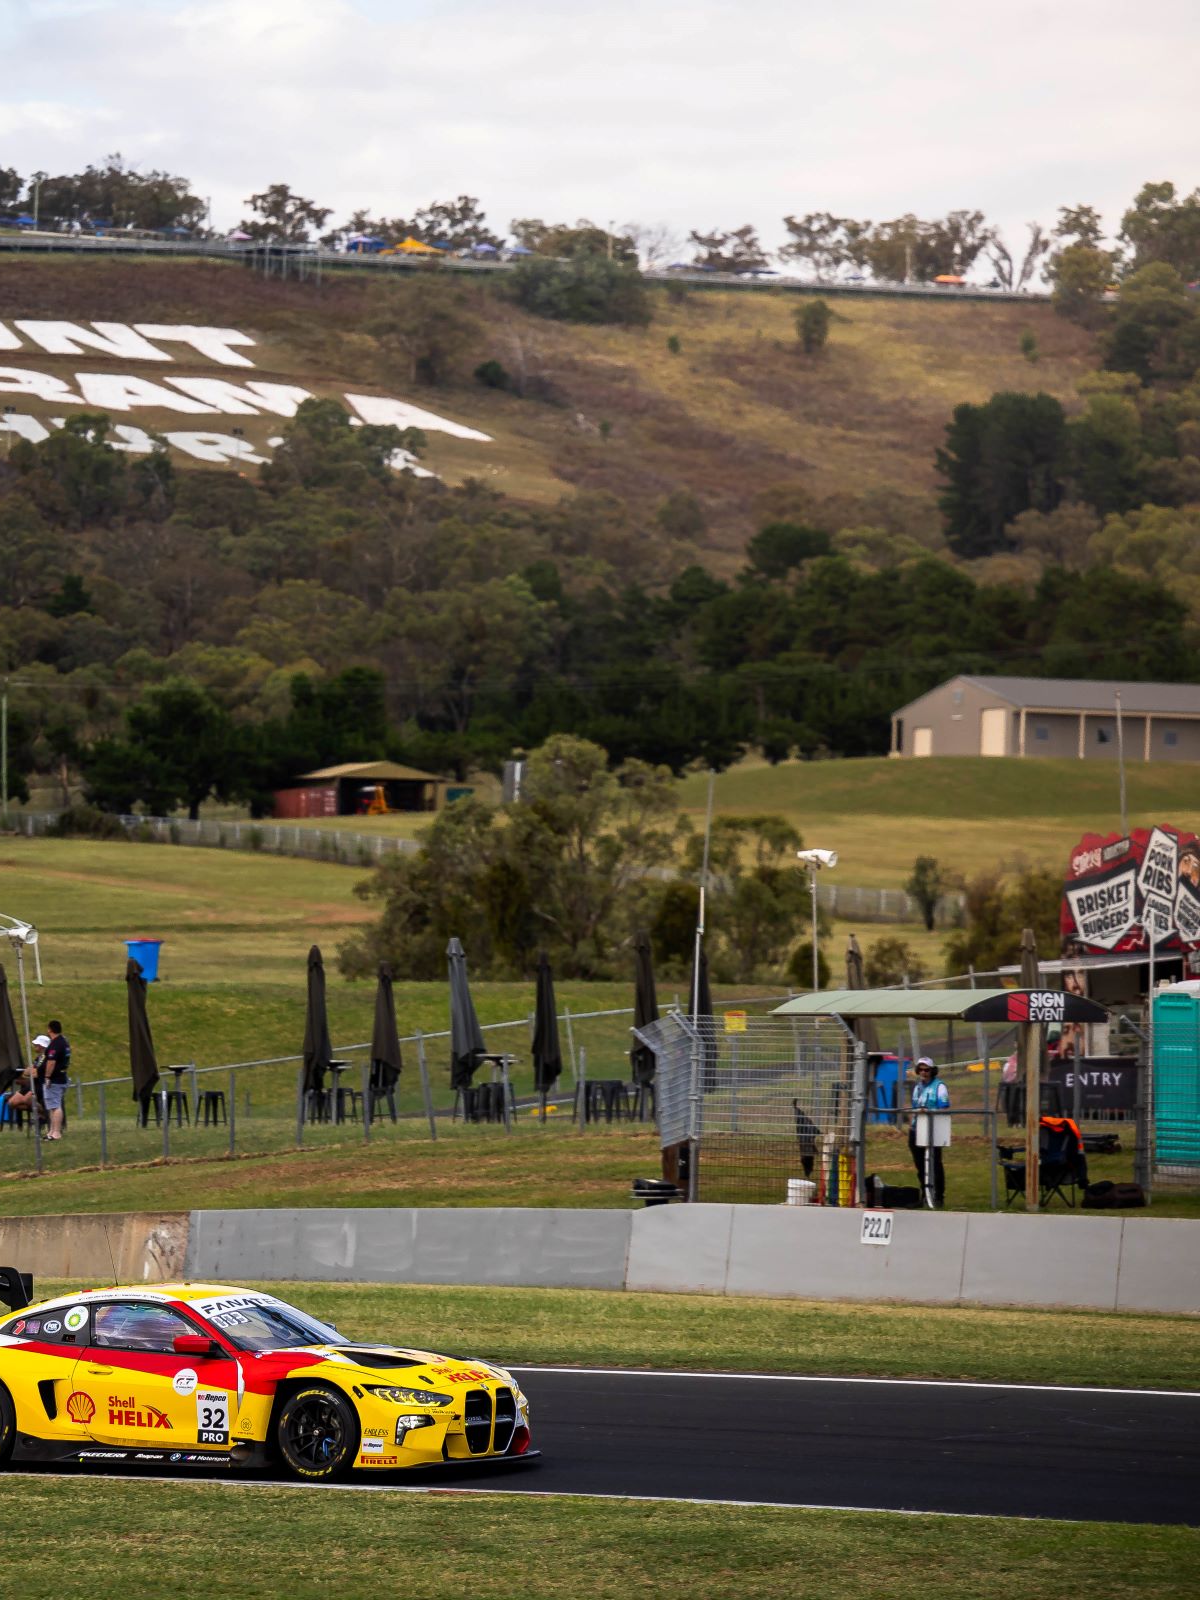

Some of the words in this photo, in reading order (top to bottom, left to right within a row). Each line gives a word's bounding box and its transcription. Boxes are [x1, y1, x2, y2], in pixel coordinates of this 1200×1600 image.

[1145, 848, 1175, 874] PORK
[1141, 865, 1173, 896] RIBS
[1076, 880, 1132, 917] BRISKET
[1082, 907, 1130, 938] BURGERS
[1029, 992, 1065, 1007] SIGN
[1029, 1007, 1065, 1021] EVENT
[1065, 1071, 1122, 1088] ENTRY
[863, 1216, 891, 1239] P22.0
[108, 1395, 135, 1408] Shell
[205, 1393, 227, 1402] Repco
[108, 1408, 169, 1430] HELIX
[201, 1407, 225, 1429] 32
[202, 1432, 224, 1443] PRO
[363, 1427, 389, 1437] ENDLESS
[361, 1456, 397, 1464] PIRELLI
